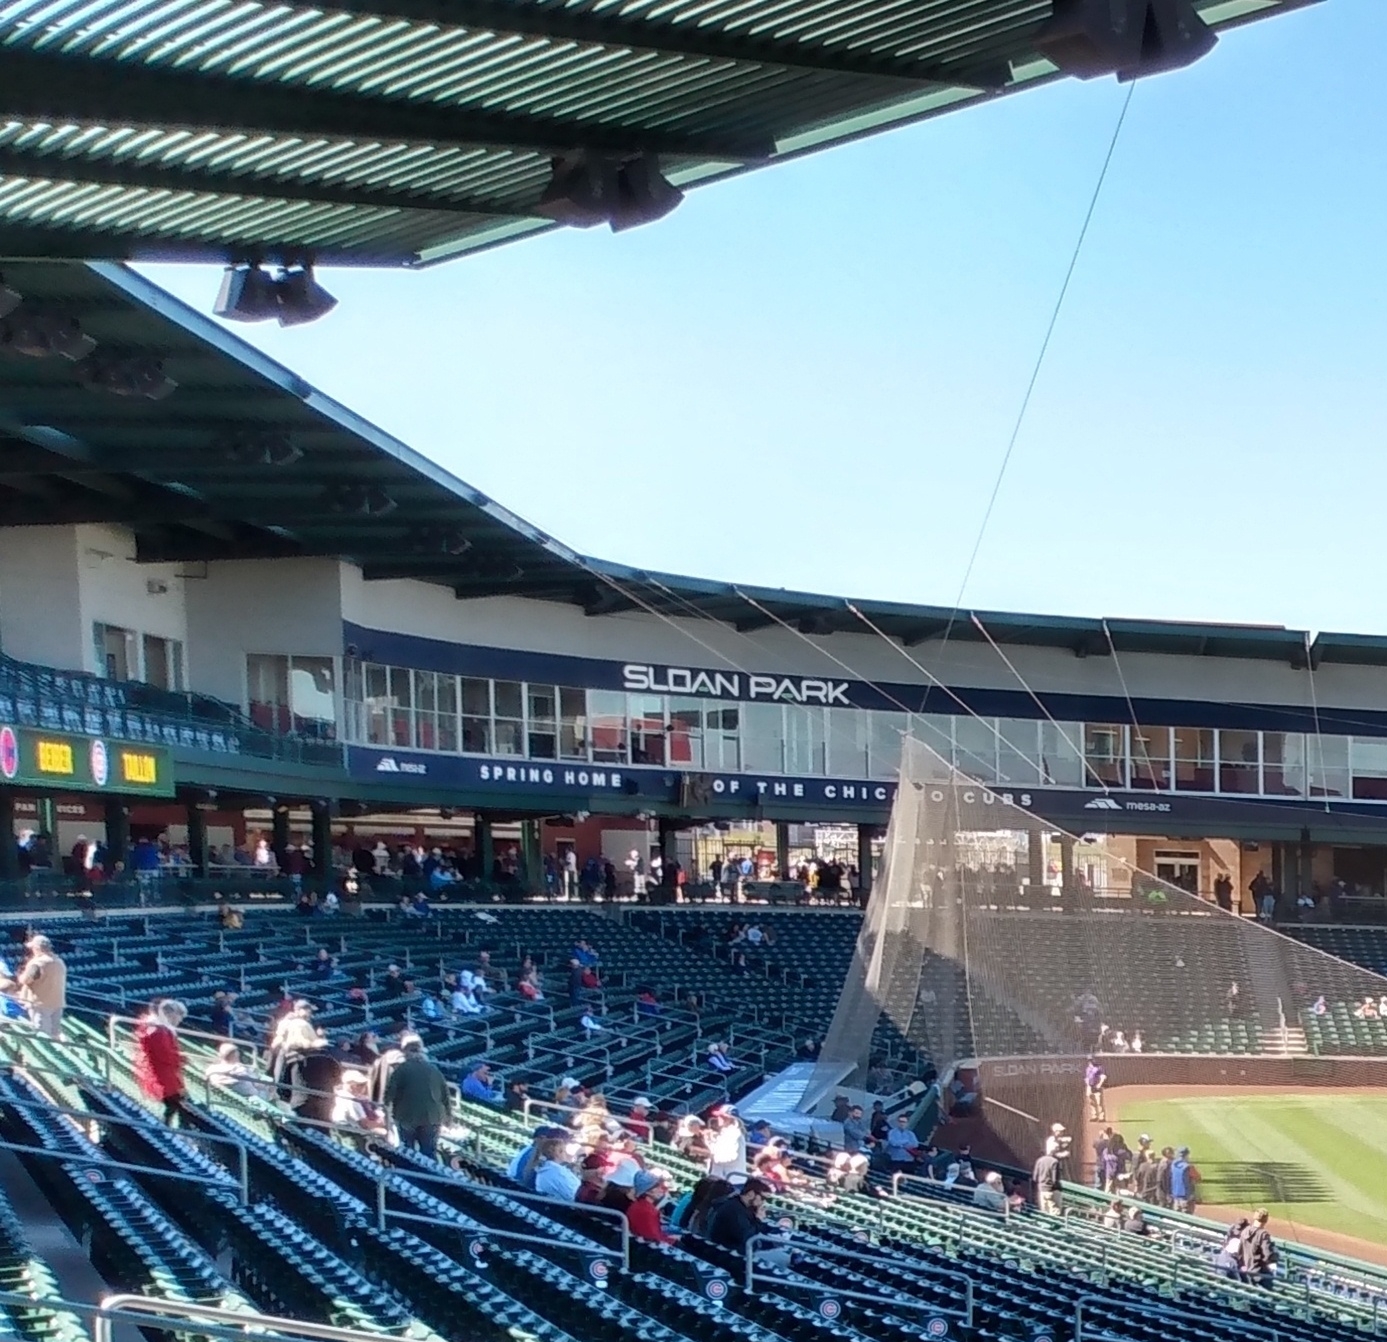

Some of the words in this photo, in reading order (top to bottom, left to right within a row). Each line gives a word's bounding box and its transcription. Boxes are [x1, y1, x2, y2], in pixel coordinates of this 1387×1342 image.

[623, 664, 740, 697] SLOAN
[750, 676, 850, 705] PARK
[480, 765, 553, 784] SPRING
[565, 771, 622, 788] HOME
[713, 779, 740, 794] OF
[757, 781, 804, 797] THE
[824, 785, 944, 803] CHICO
[963, 791, 1032, 807] CUBS
